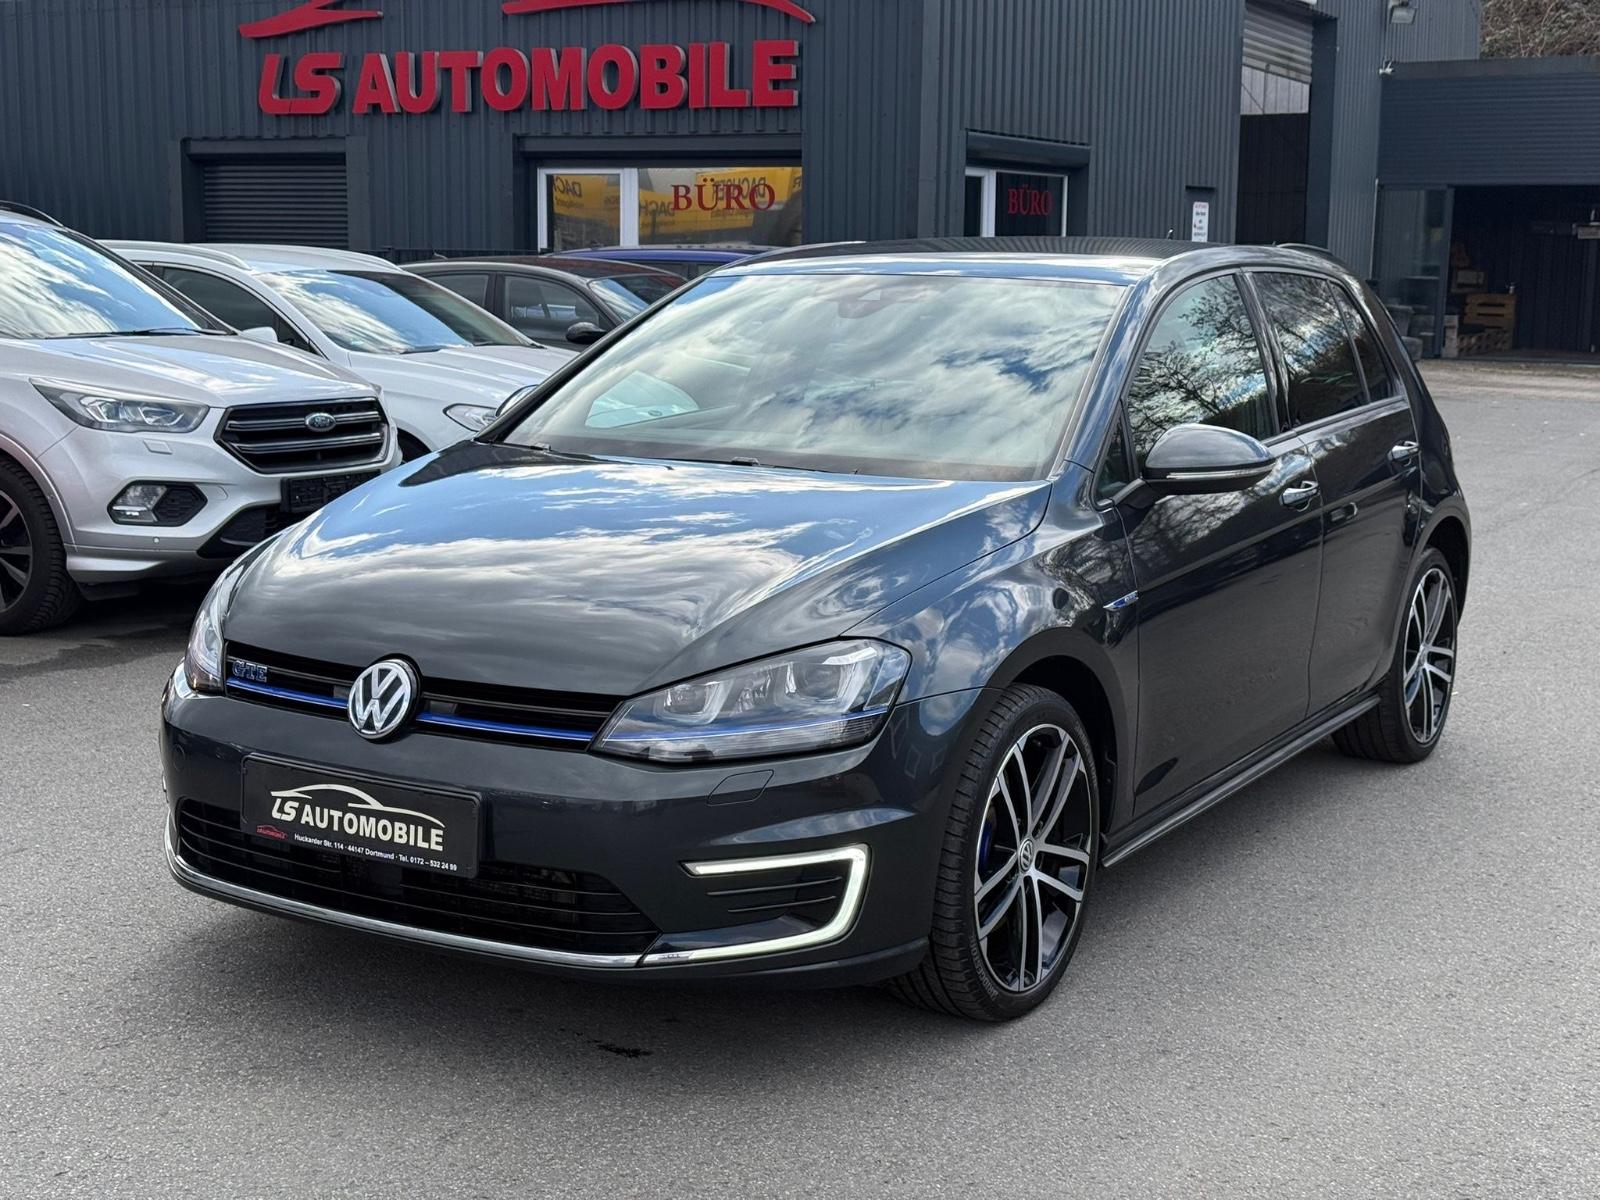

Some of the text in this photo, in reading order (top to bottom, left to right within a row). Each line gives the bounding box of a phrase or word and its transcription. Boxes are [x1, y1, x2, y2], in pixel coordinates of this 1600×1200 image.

[258, 40, 799, 115] LS AUTOMOBILE
[671, 177, 775, 211] BÜRO
[1008, 185, 1053, 216] BÜRO
[233, 660, 268, 682] GTE
[271, 798, 444, 851] LS AUTOMOBILE
[294, 833, 322, 845] Huckarder
[323, 839, 333, 848] Str.
[334, 842, 344, 850] 114
[348, 845, 364, 854] 44147
[365, 848, 394, 860] Dortmund
[399, 854, 409, 862] Tel.
[410, 856, 424, 865] 0172
[430, 860, 440, 868] 532
[441, 862, 449, 870] 24
